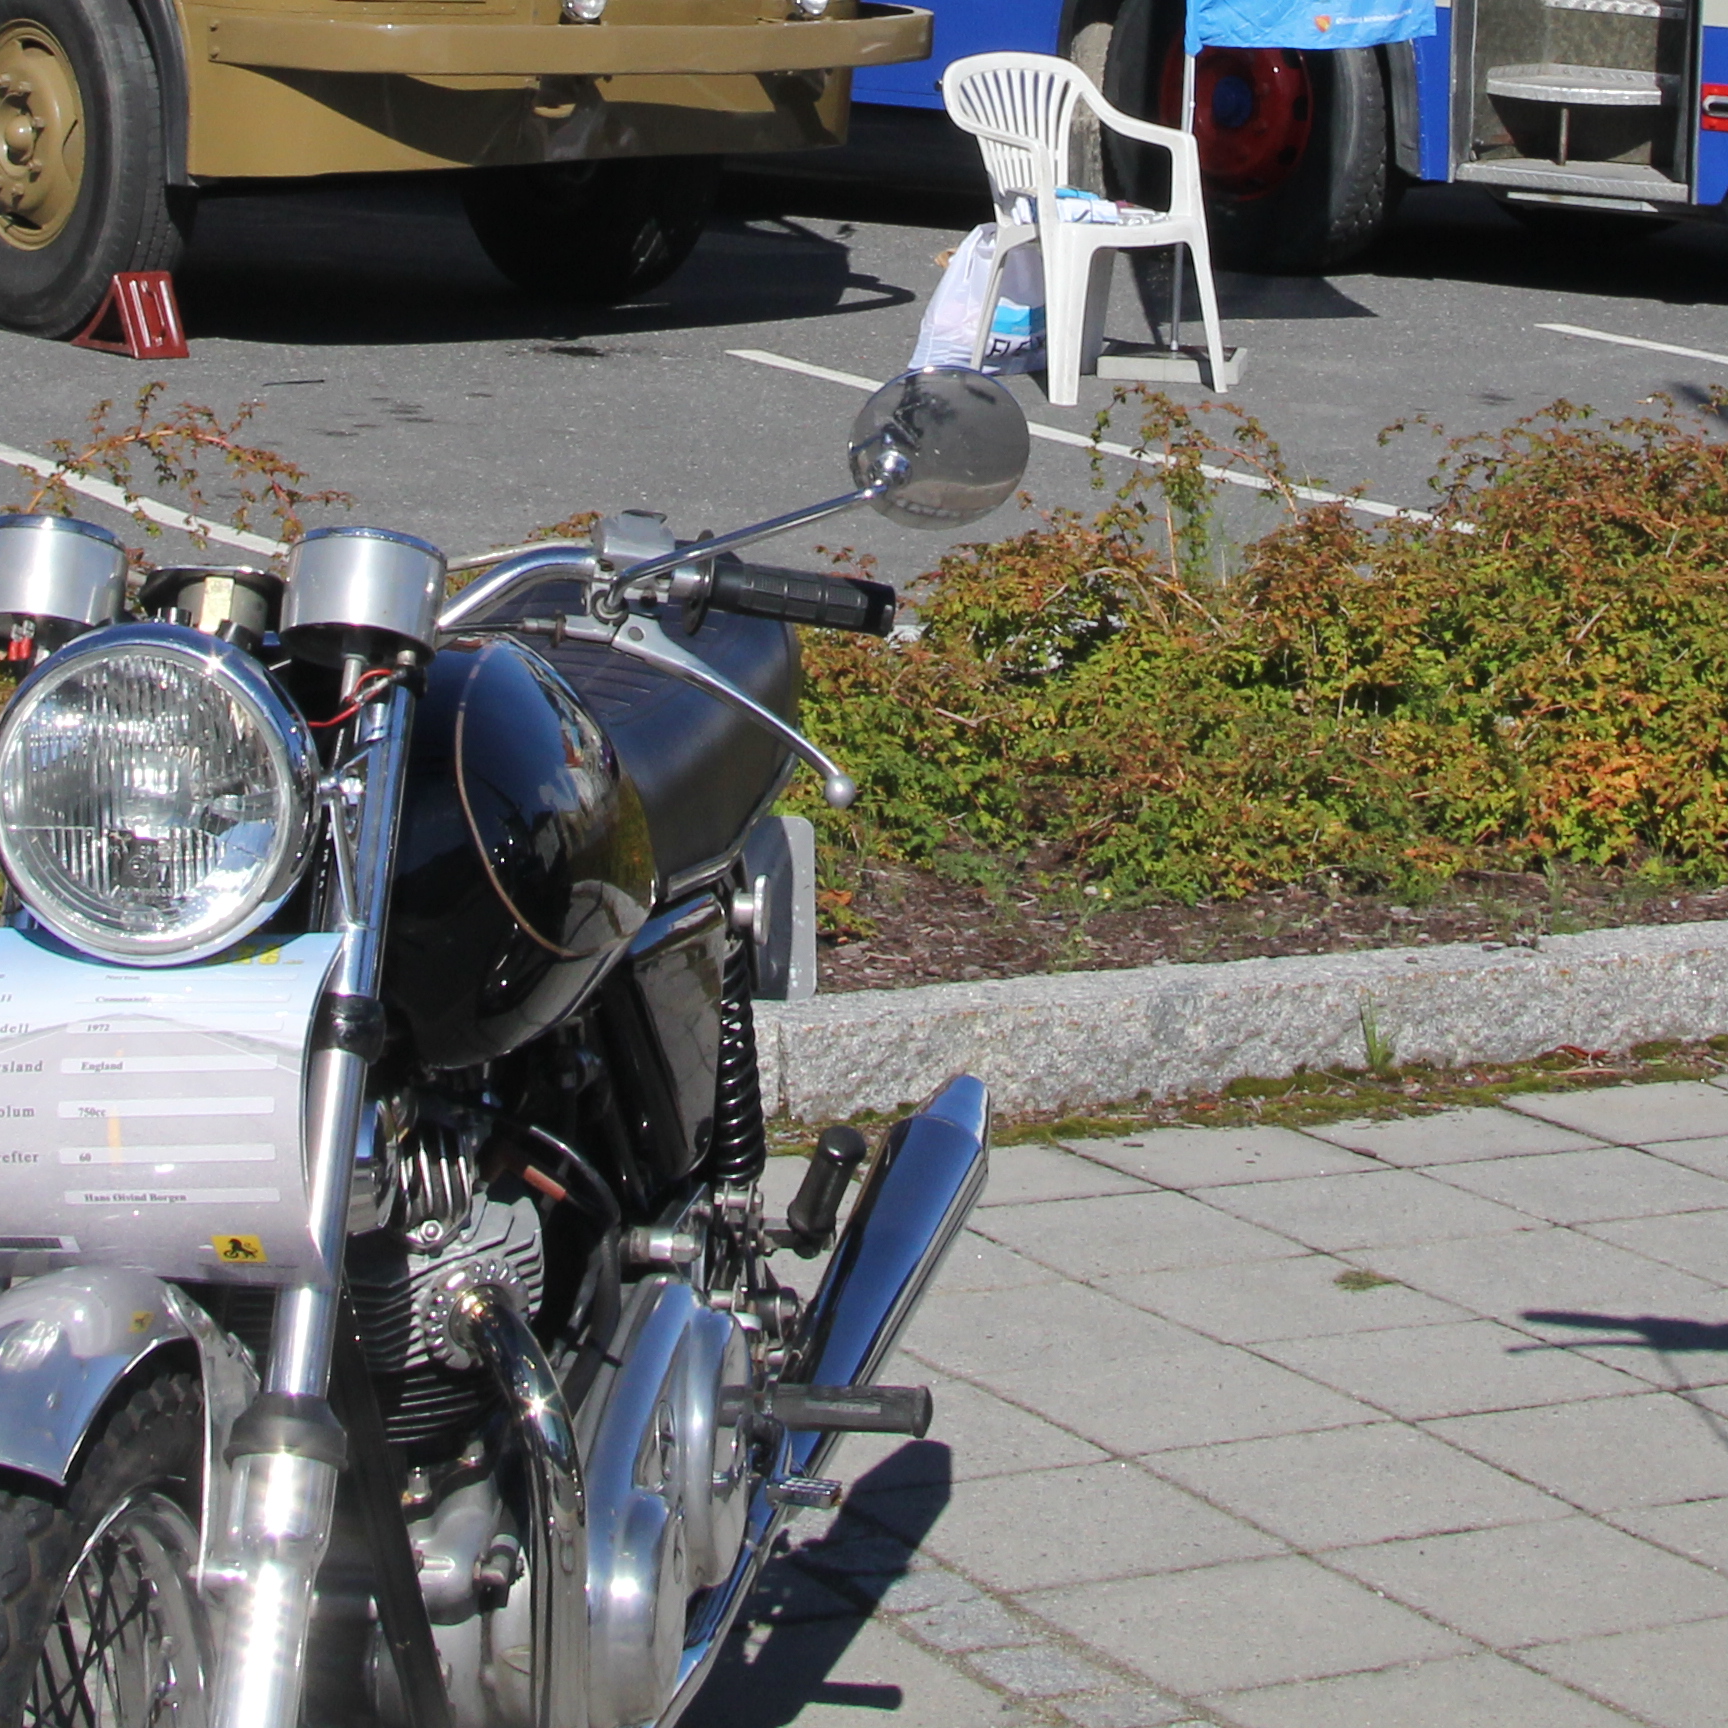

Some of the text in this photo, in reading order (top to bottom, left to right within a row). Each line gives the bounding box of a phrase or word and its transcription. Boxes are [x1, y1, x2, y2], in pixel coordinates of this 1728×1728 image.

[85, 1023, 111, 1033] 1972
[80, 1061, 124, 1073] England
[77, 1106, 107, 1119] 750cc
[78, 1152, 92, 1163] 60
[84, 1192, 111, 1203] Hans
